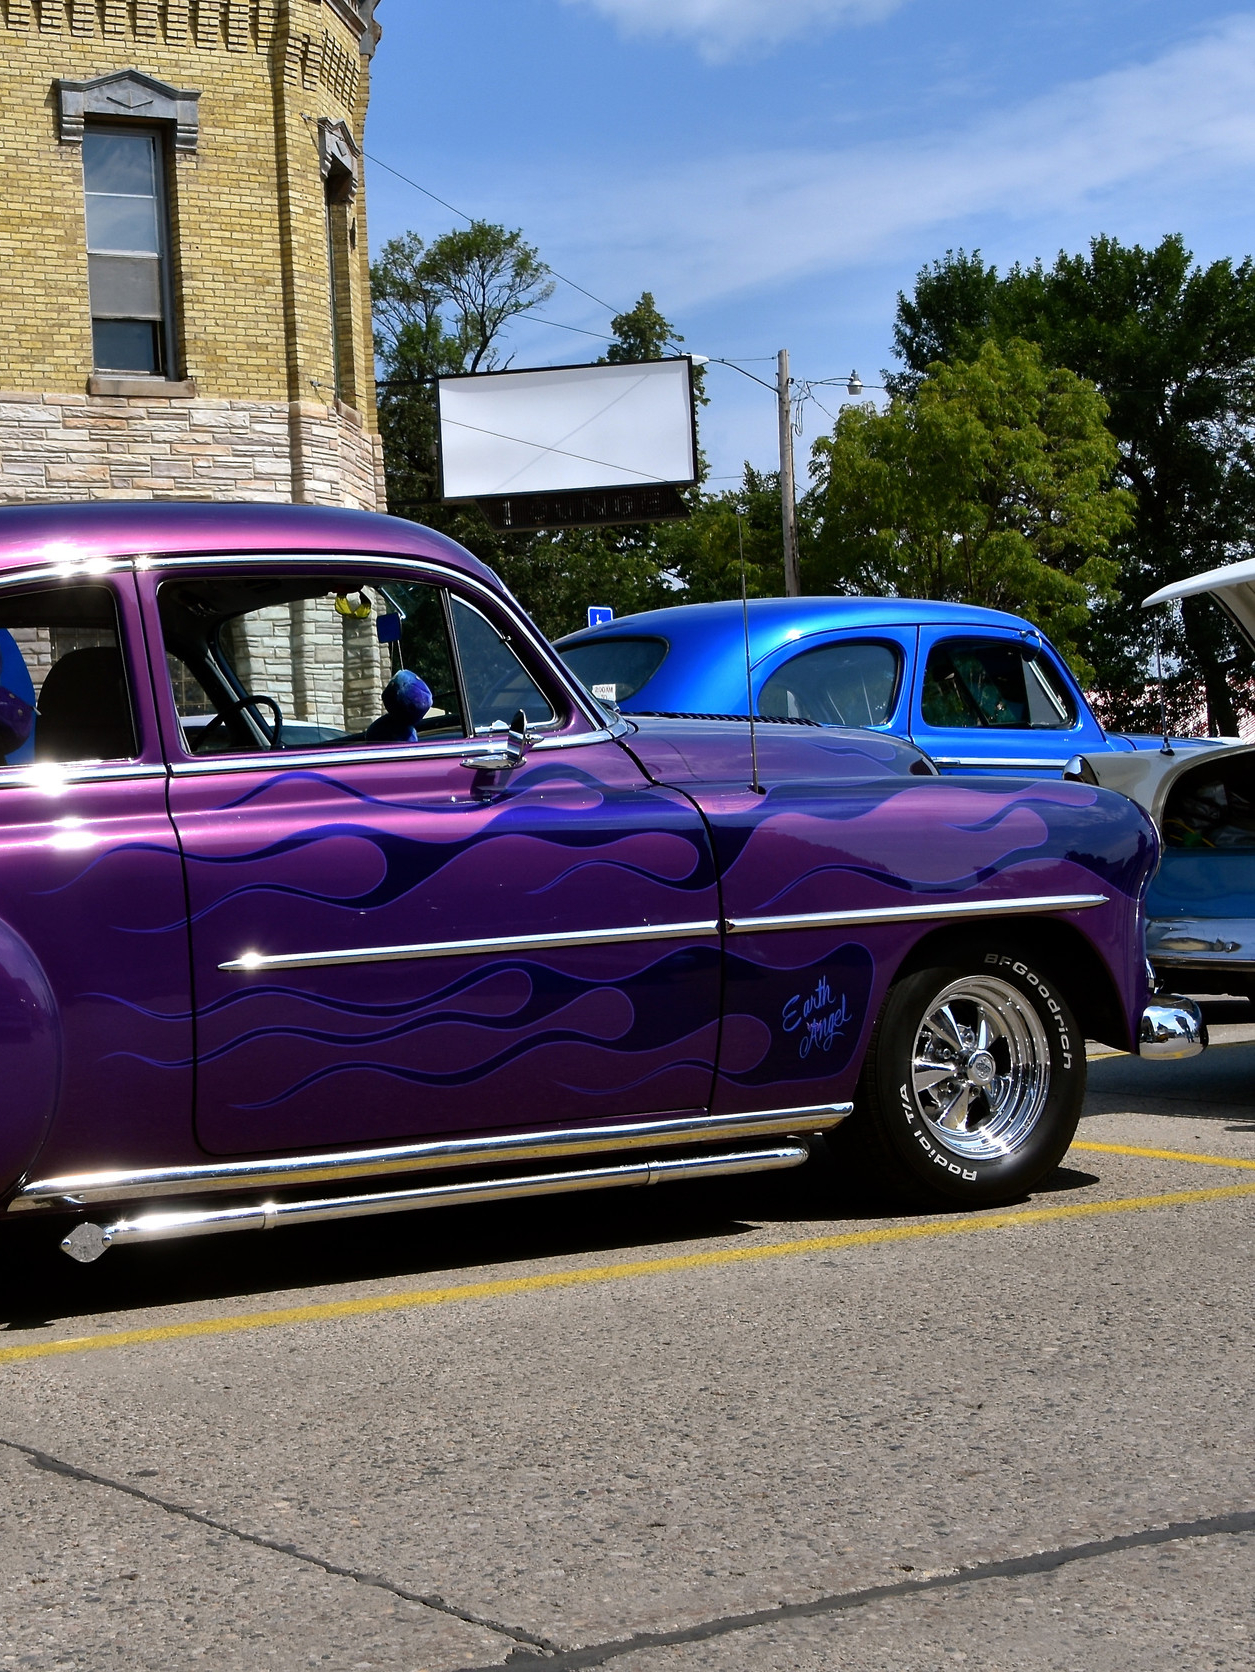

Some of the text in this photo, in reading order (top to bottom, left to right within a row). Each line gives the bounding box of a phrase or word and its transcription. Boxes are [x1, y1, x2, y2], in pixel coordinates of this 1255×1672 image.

[782, 975, 836, 1032] Earth
[799, 993, 853, 1059] Angel
[984, 954, 1073, 1070] BFGoodrich
[899, 1083, 977, 1181] Radial T/A
